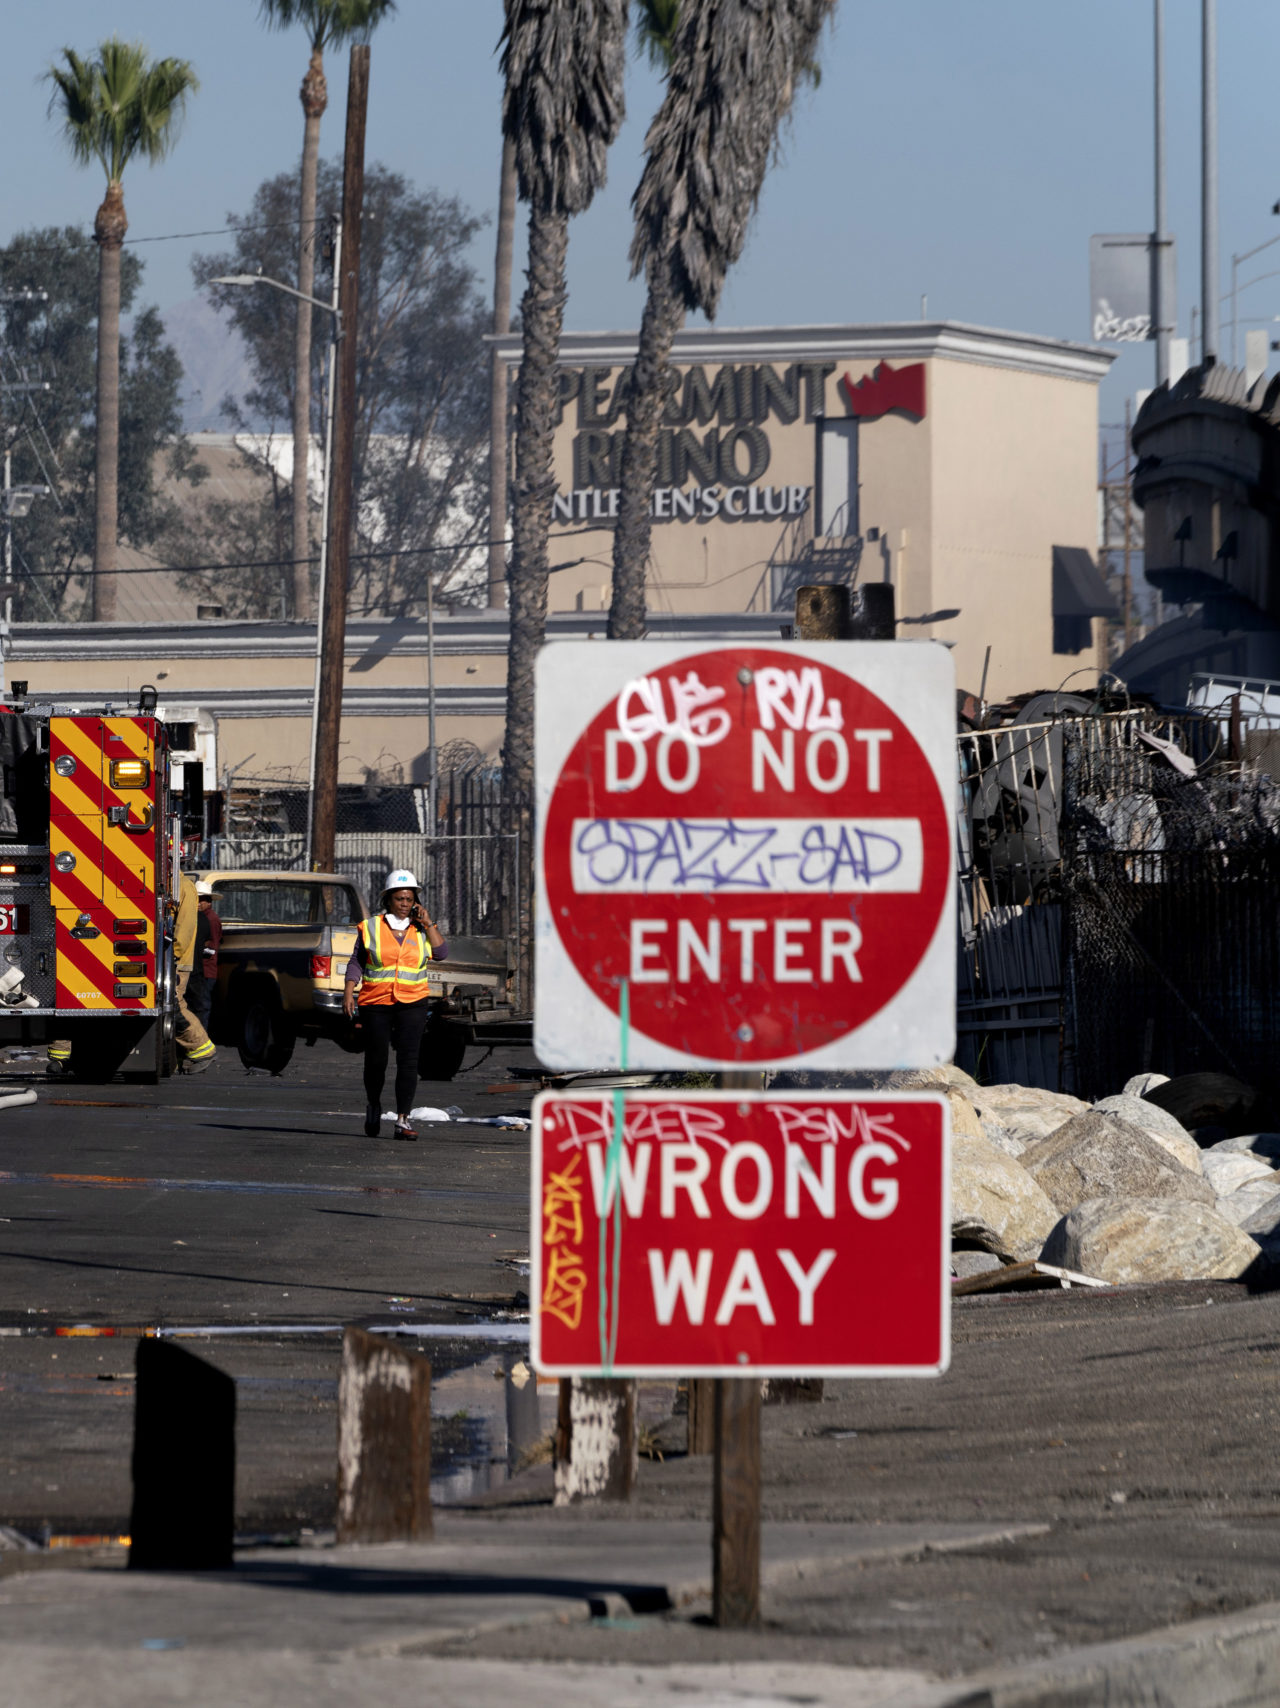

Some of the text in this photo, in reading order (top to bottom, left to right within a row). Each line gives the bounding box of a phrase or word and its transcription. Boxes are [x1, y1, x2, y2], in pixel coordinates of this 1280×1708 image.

[577, 425, 770, 484] RINO
[723, 484, 809, 516] CLUB
[605, 729, 892, 793] DO NOT
[630, 918, 863, 983] ENTER
[587, 1141, 899, 1219] WRONG
[648, 1248, 837, 1326] WAY
